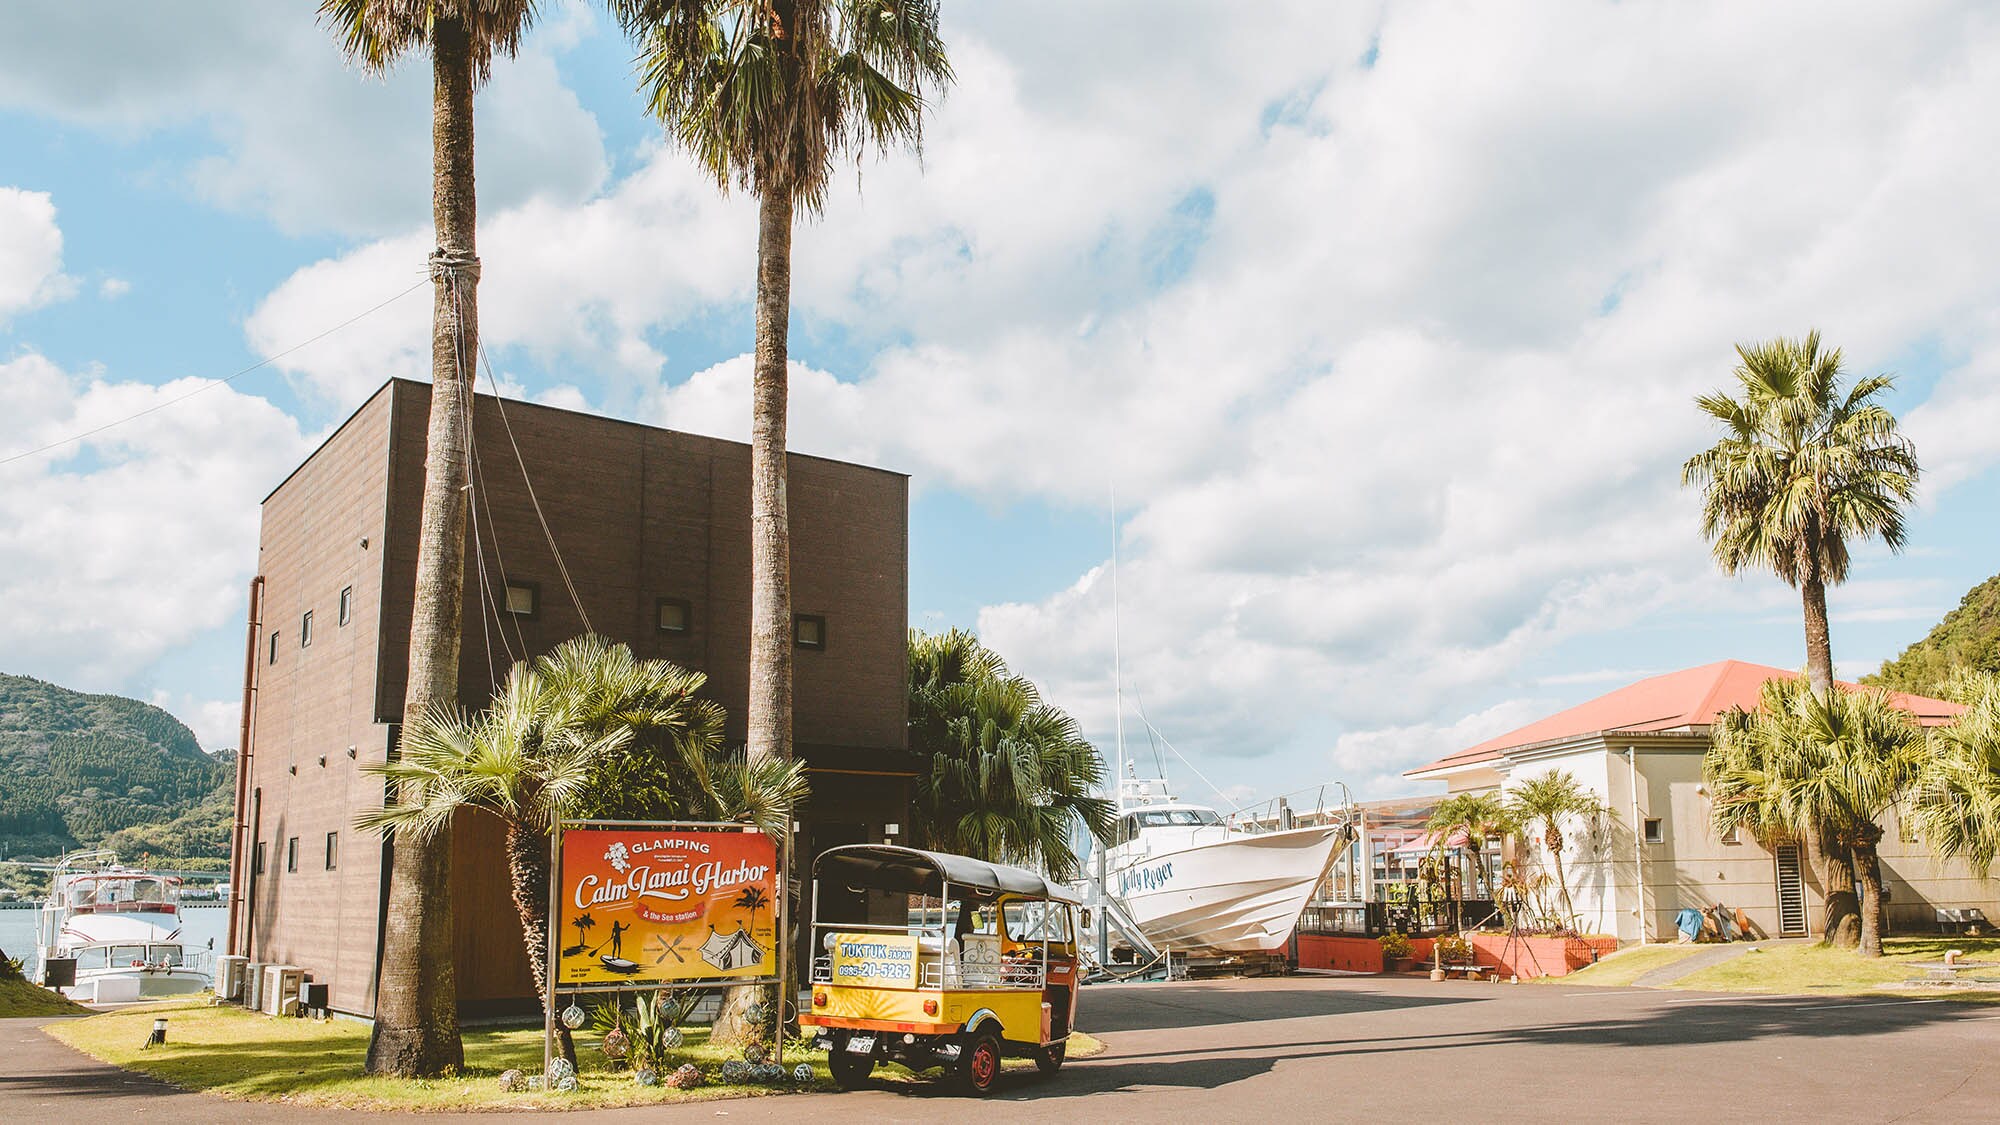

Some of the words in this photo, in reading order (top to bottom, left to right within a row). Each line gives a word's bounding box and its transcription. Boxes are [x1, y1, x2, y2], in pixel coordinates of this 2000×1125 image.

[632, 839, 711, 854] GLAMPING
[575, 874, 630, 909] Calm
[691, 859, 769, 894] Harbor
[1143, 861, 1173, 890] Roger
[643, 910, 649, 919] &
[650, 911, 661, 920] the
[661, 913, 674, 921] Sea
[675, 911, 699, 920] station
[840, 943, 887, 959] TUKTUK
[888, 949, 912, 960] JAPAN
[838, 961, 911, 979] 0985-20-5262
